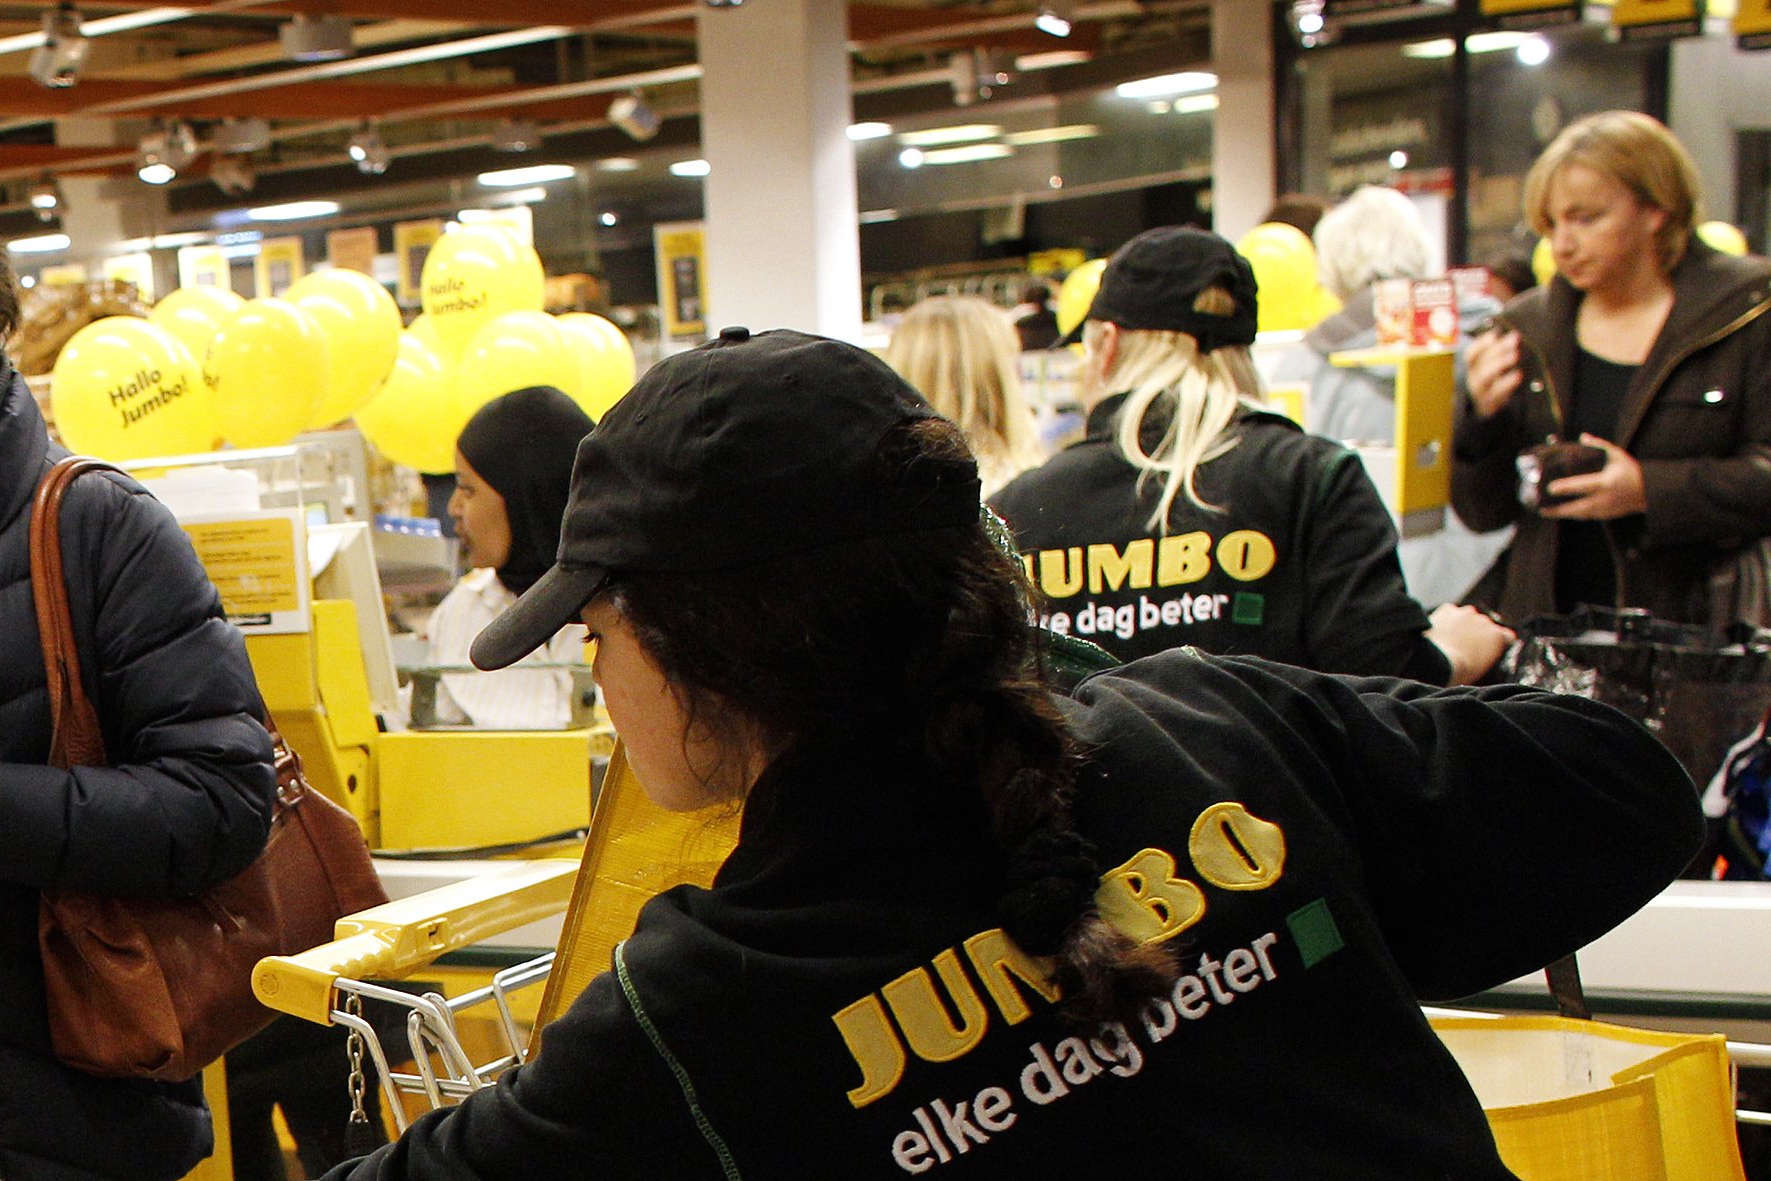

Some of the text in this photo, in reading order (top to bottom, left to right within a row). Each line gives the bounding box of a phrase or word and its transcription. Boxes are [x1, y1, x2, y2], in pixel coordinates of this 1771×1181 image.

[108, 370, 162, 408] Hallo
[121, 374, 190, 429] Jumbo!
[1023, 529, 1277, 599] UMBO
[1076, 601, 1134, 640] dag
[1139, 590, 1231, 630] beter
[891, 931, 1279, 1176] elke dag beter
